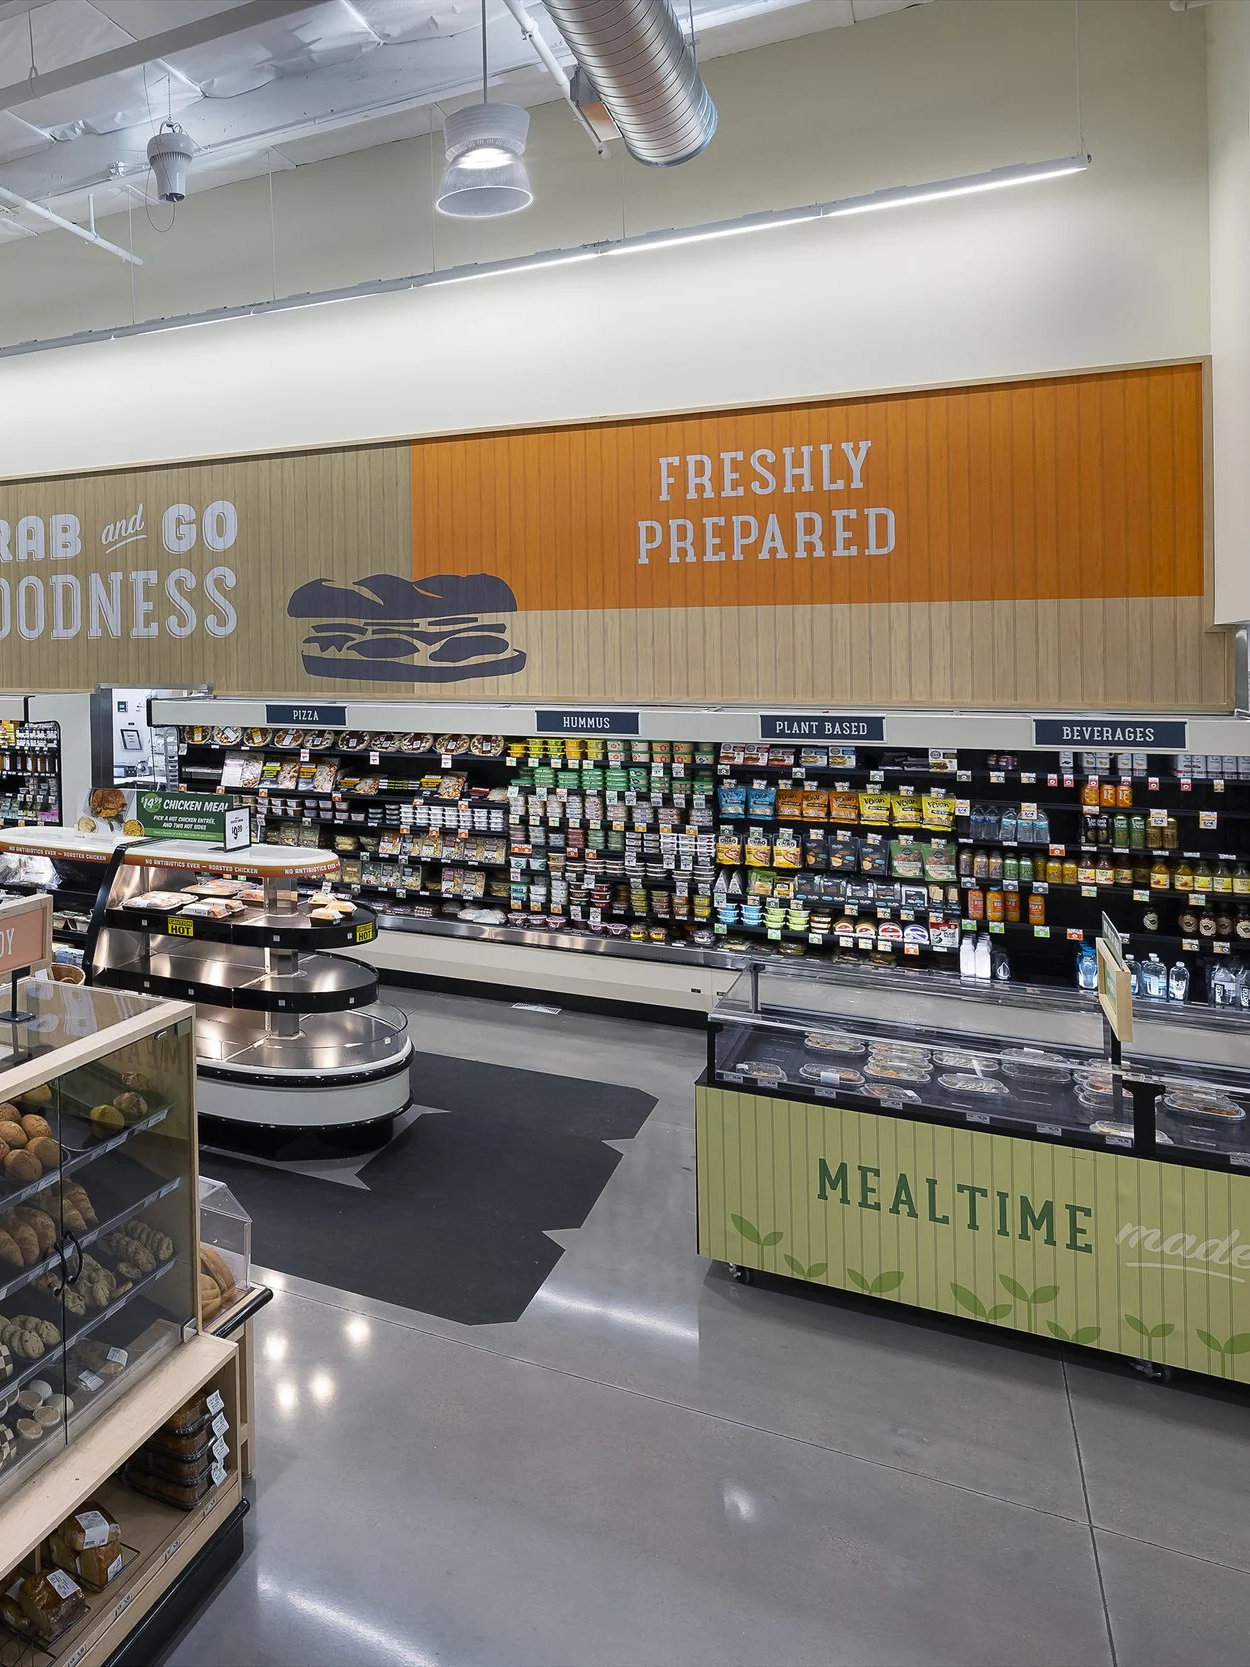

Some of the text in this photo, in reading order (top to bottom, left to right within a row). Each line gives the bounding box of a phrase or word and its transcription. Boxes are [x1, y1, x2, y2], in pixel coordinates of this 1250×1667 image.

[658, 440, 872, 502] FRESHLY
[101, 503, 145, 548] and
[160, 500, 239, 556] GO
[637, 506, 896, 565] PREPARED
[293, 710, 319, 721] PIZZA
[562, 715, 611, 731] HUMMUS
[775, 720, 869, 736] PLANT BASED
[1061, 725, 1156, 744] BEVERAGES
[163, 799, 201, 811] CHICKEN
[16, 847, 44, 855] ANTIBIOTICS
[63, 851, 85, 859] ROASTED
[86, 853, 107, 861] CHICKEN
[154, 859, 185, 868] ANTIBIOTICS
[186, 861, 200, 869] EVER
[208, 864, 234, 872] ROASTED
[234, 866, 258, 874] CHICKEN
[295, 866, 326, 874] ANTIBIOTICS
[168, 919, 193, 927] CAUTION
[170, 925, 192, 936] HOT
[358, 929, 373, 942] HOT
[817, 1157, 1250, 1270] MEALTIME made
